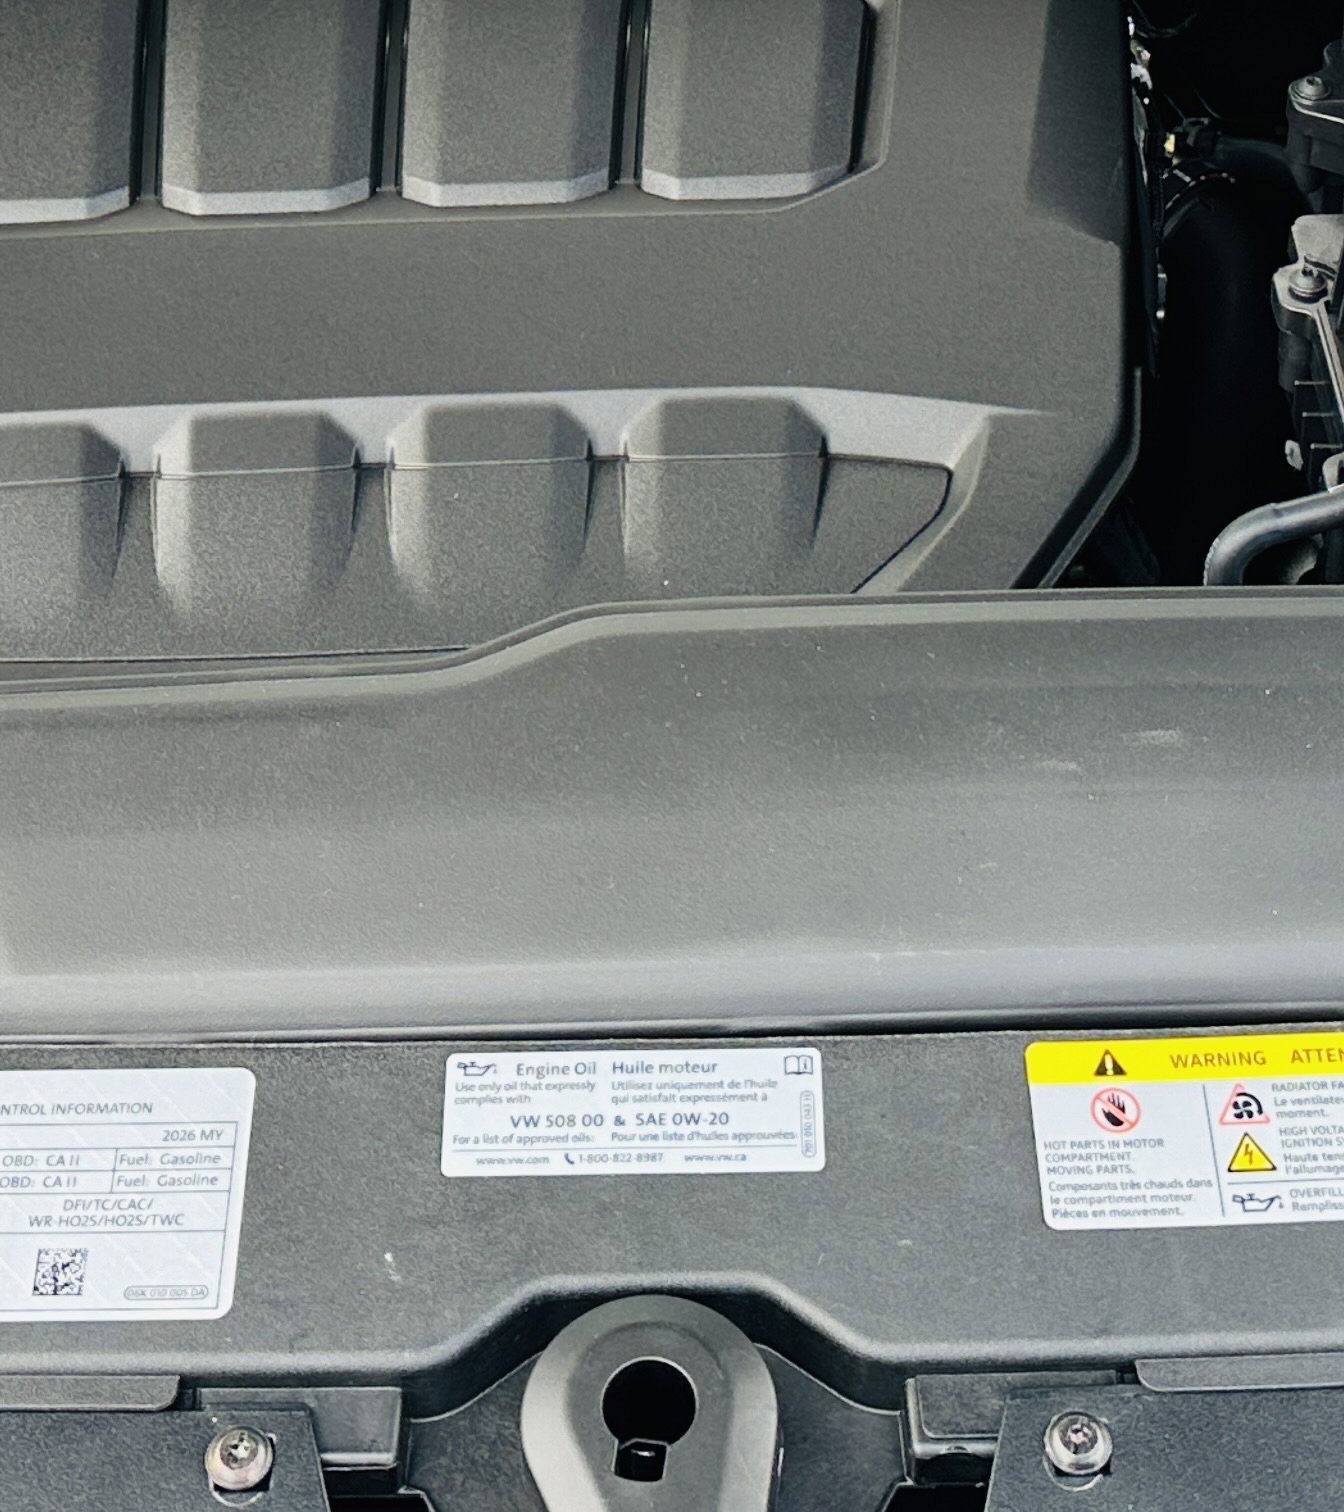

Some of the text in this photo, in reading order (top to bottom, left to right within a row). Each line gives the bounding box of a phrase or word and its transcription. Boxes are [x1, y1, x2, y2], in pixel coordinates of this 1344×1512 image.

[1170, 1051, 1267, 1069] WARNING
[516, 1061, 596, 1080] Engine Oil
[612, 1061, 718, 1074] Huile moteur
[455, 1080, 596, 1093] Use only oil that expressly
[611, 1080, 653, 1091] Utilisez
[655, 1080, 724, 1092] uniquement
[727, 1079, 742, 1089] de
[1272, 1081, 1328, 1092] RADIATOR
[454, 1095, 532, 1106] complies with
[611, 1094, 630, 1104] qui
[632, 1093, 676, 1104] satisfait
[761, 1091, 768, 1102] à
[1274, 1097, 1287, 1106] Le
[51, 1103, 153, 1115] INFORMATION
[510, 1112, 729, 1128] VW 508 00 & SAE 0W-20
[162, 1129, 196, 1142] 2026
[200, 1129, 224, 1141] MY
[611, 1131, 636, 1141] Pour
[662, 1131, 685, 1141] liste
[1279, 1126, 1310, 1137] HIGH
[453, 1134, 471, 1145] For
[473, 1136, 480, 1144] a
[482, 1134, 499, 1144] list
[501, 1134, 514, 1143] of
[516, 1134, 569, 1147] approved
[1044, 1138, 1165, 1151] HOT PARTS IN MOTOR
[1281, 1137, 1333, 1148] IGNITION
[46, 1155, 65, 1167] CA
[160, 1152, 222, 1165] Gasoline
[475, 1156, 549, 1166] www.vw.com
[684, 1154, 747, 1162] www.vw.ca
[1284, 1153, 1318, 1163] Haute
[1047, 1165, 1093, 1175] MOVING
[43, 1176, 62, 1188] CA
[157, 1173, 218, 1187] Gasoline
[1049, 1177, 1213, 1193] Composants très chauds dans
[63, 1198, 154, 1212] DFI/TC/CAC/
[1050, 1195, 1061, 1206] le
[1064, 1194, 1147, 1207] compartiment
[1052, 1207, 1088, 1219] Pièces
[1092, 1209, 1106, 1218] en
